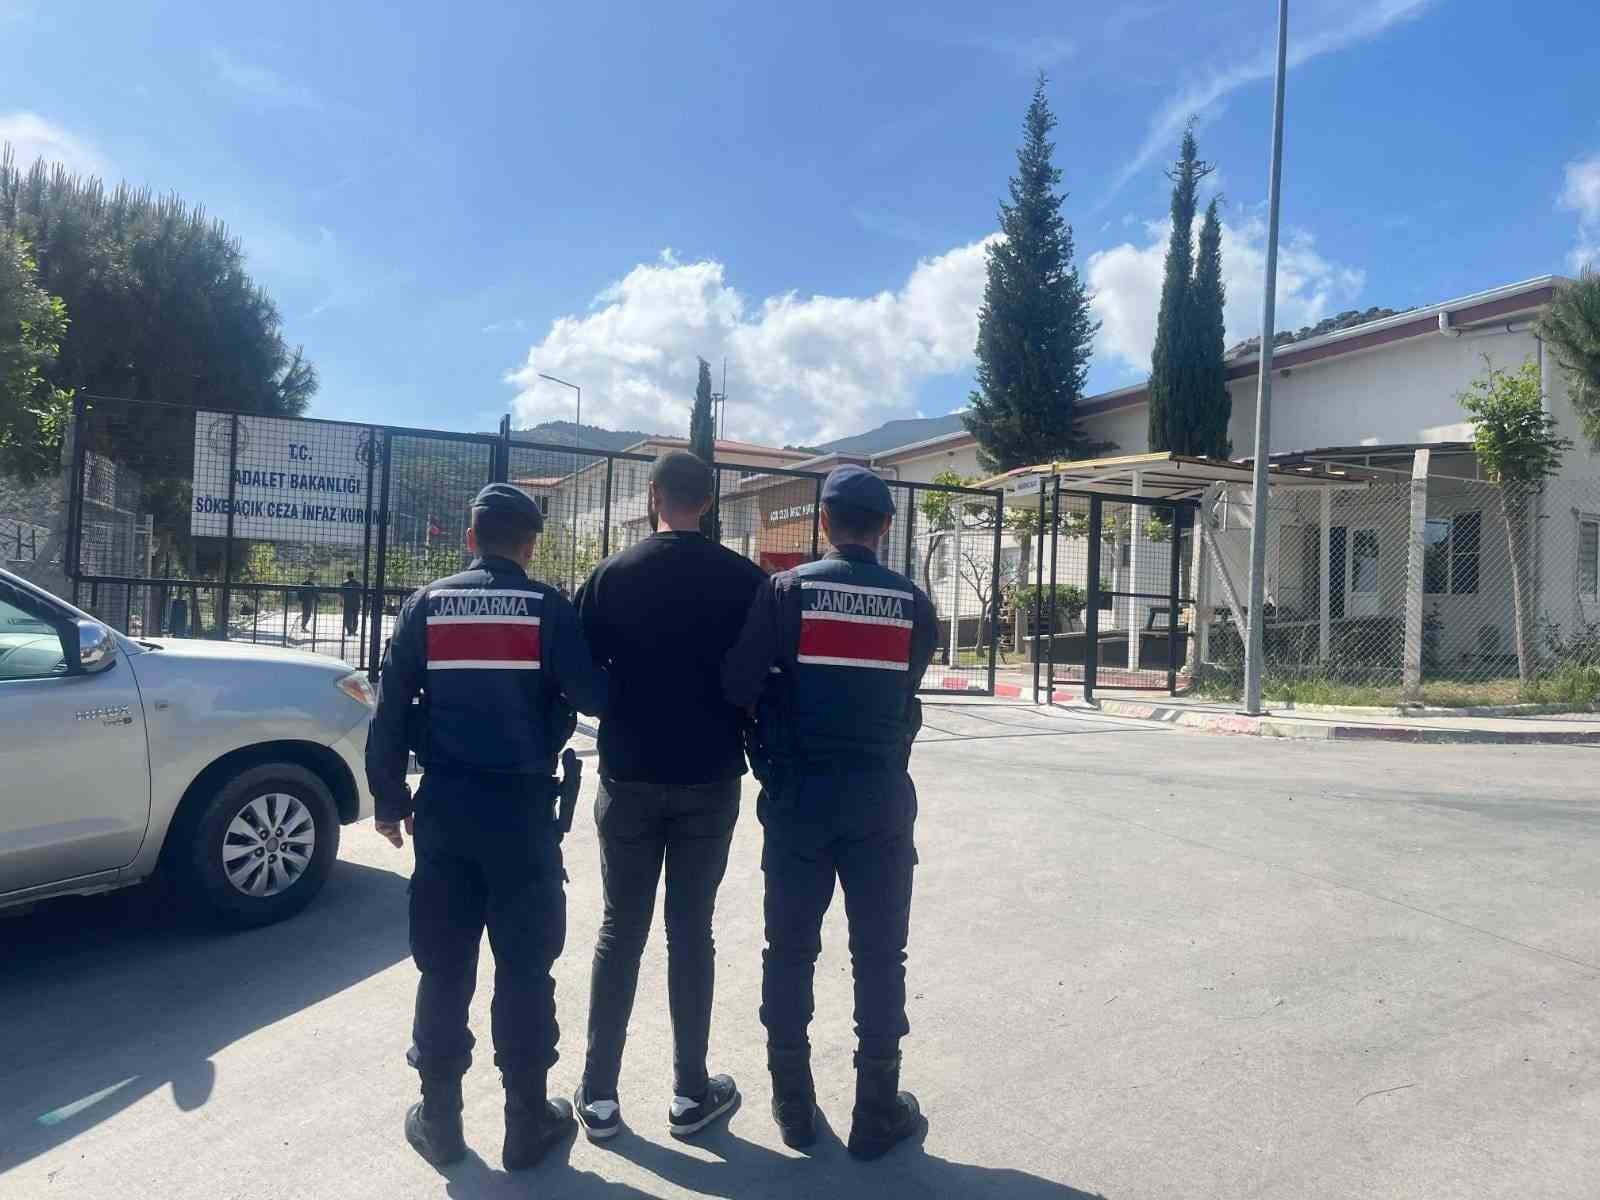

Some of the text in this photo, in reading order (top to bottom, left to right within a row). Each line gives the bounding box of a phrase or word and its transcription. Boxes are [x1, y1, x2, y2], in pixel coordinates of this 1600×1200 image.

[289, 443, 313, 460] T.C.
[232, 470, 360, 494] ADALET BAKANLIĞI
[195, 495, 231, 514] SÖKE
[233, 501, 263, 519] AÇIK
[268, 502, 299, 519] CEZA
[303, 501, 337, 521] İNFAZ
[433, 596, 529, 617] JANDARMA
[810, 589, 904, 619] JANDARMA
